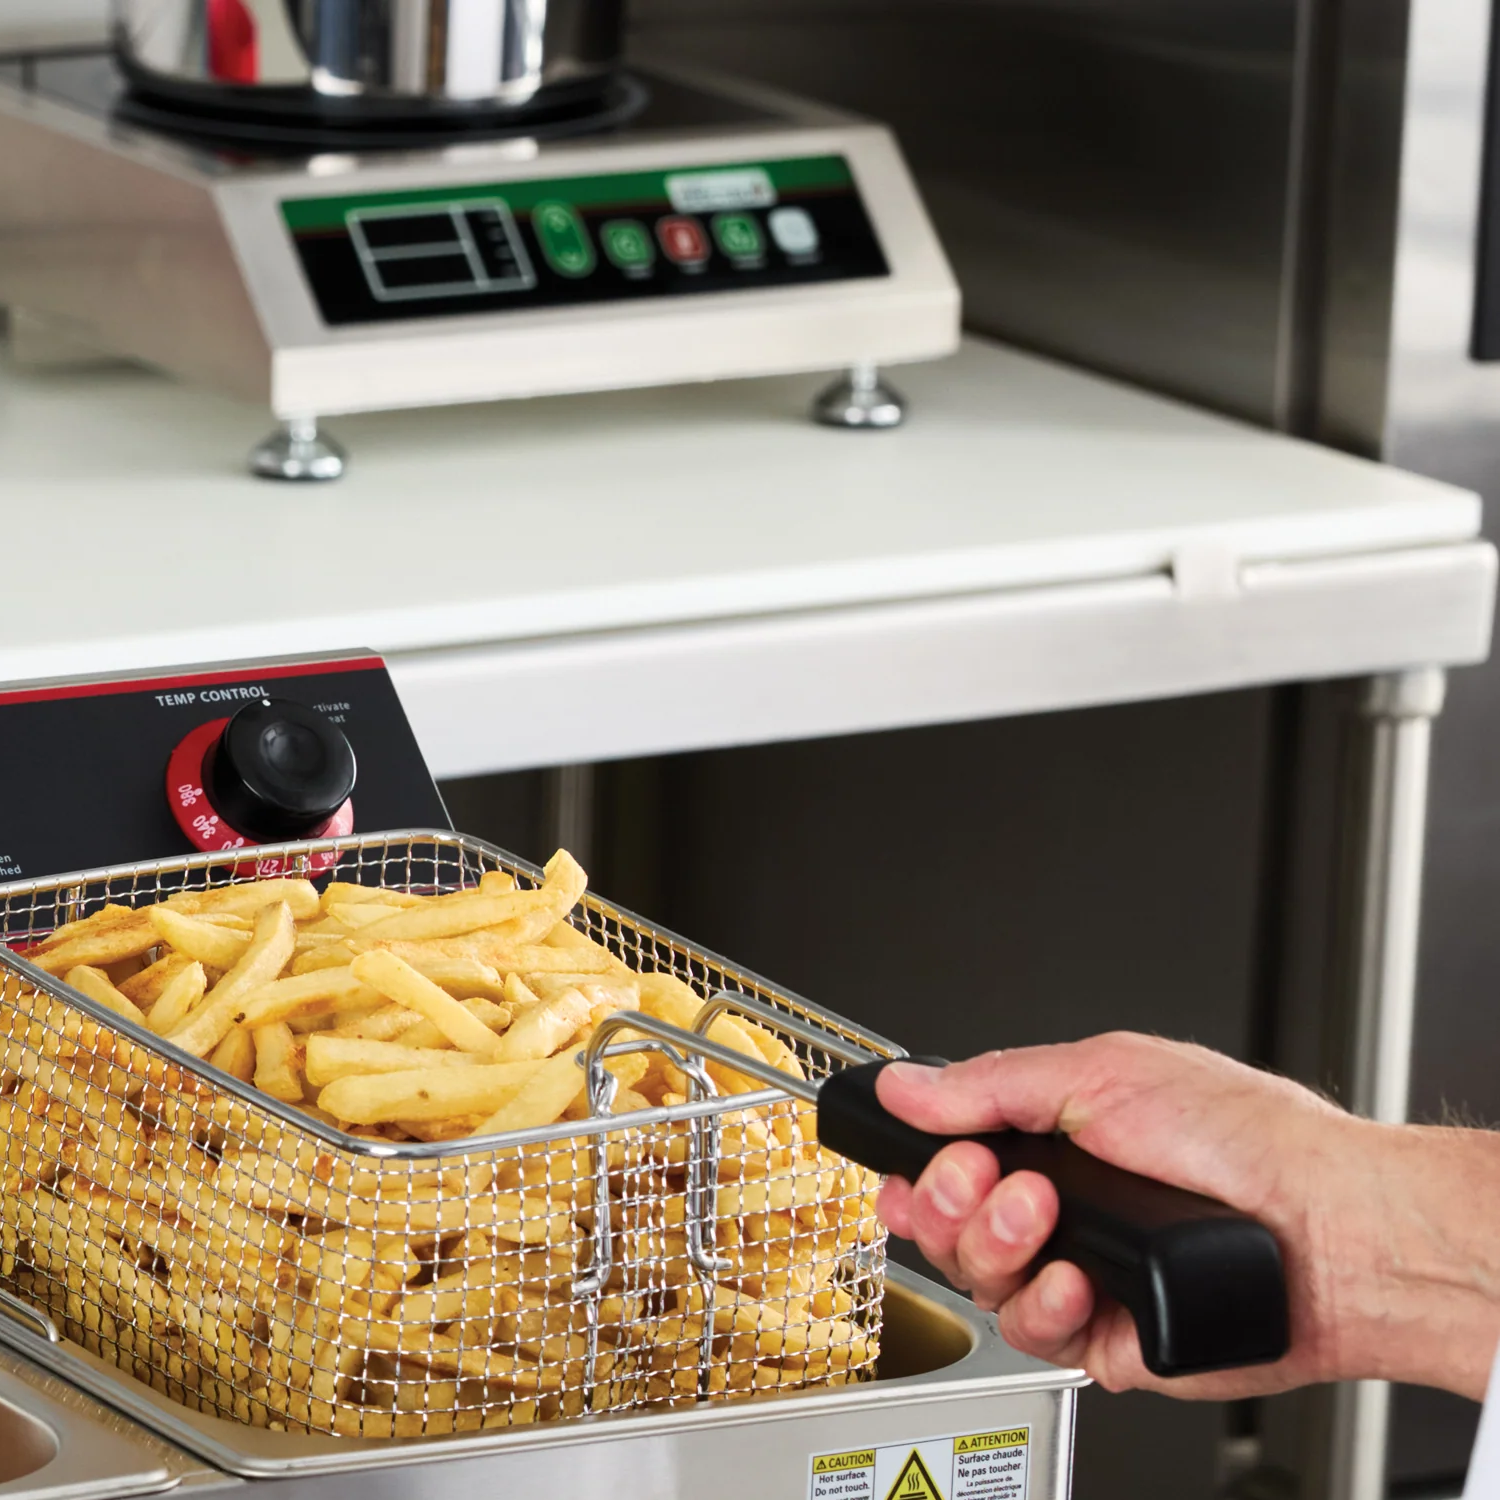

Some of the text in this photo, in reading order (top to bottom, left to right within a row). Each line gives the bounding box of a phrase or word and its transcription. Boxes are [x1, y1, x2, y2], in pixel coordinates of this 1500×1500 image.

[155, 686, 269, 707] TEMP CONTROL
[313, 701, 350, 712] tivate
[178, 784, 196, 807] 380
[192, 815, 216, 839] 340
[971, 1431, 1026, 1448] ATTENTION
[829, 1453, 873, 1468] CAUTION
[958, 1448, 1024, 1465] Surface chaude.
[819, 1471, 867, 1483] Hot surface.
[958, 1462, 1023, 1478] Ne pas toucher.
[815, 1488, 826, 1496] Do
[846, 1482, 870, 1492] touch.
